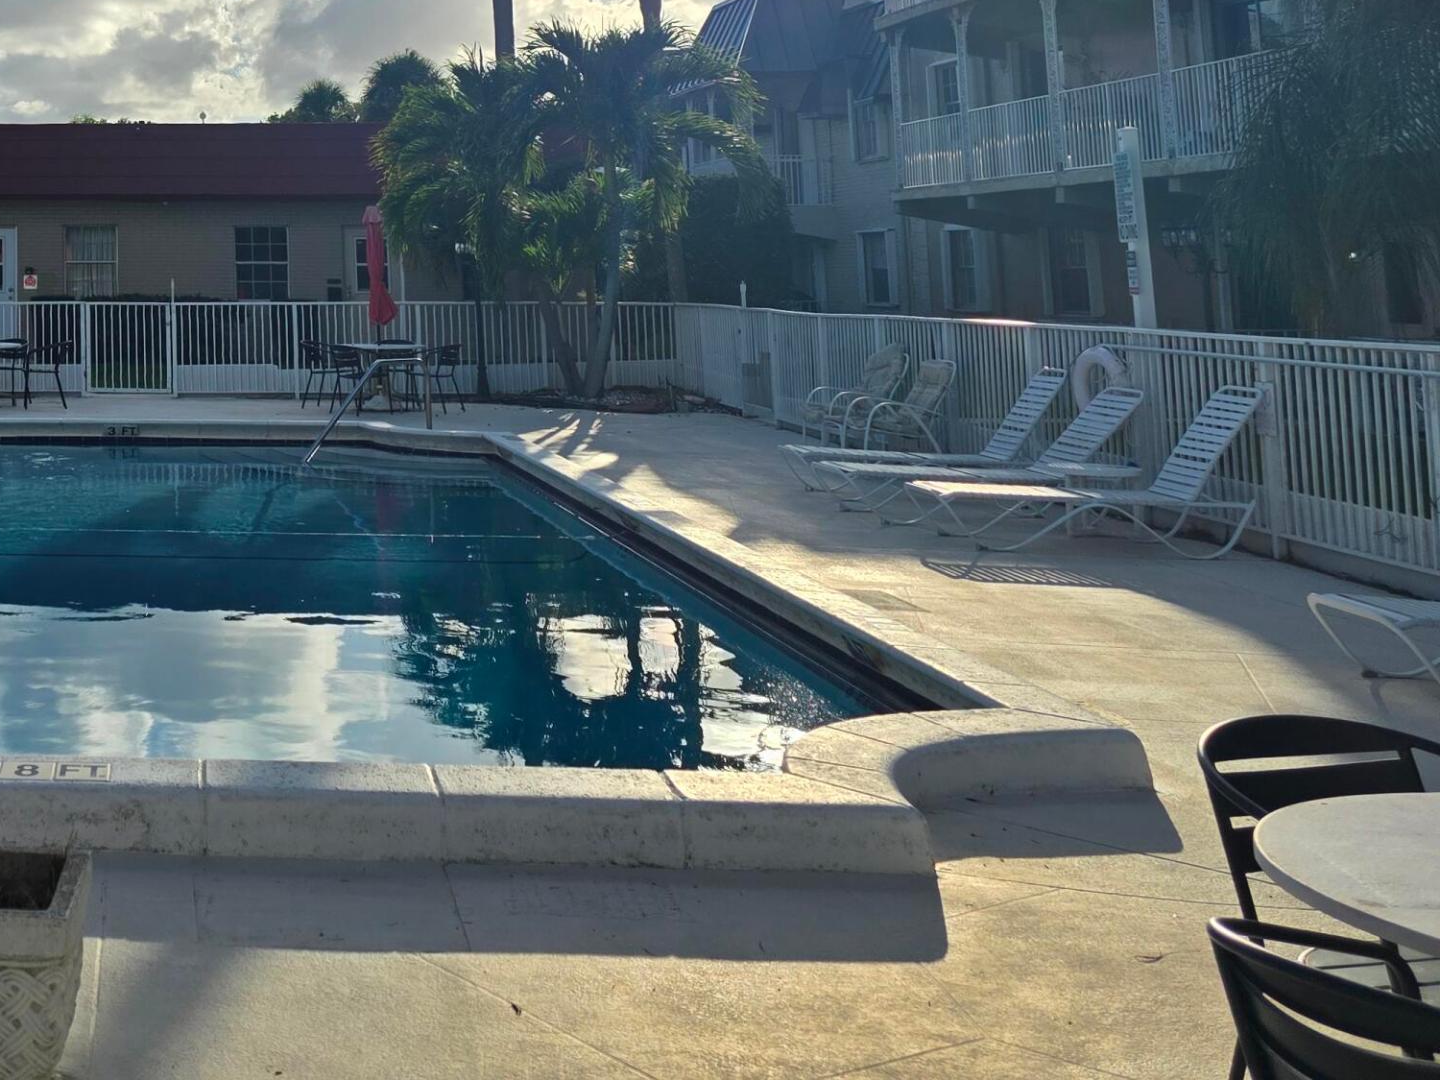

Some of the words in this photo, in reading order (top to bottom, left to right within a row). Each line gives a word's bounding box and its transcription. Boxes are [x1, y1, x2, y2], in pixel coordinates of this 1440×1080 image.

[107, 426, 116, 436] 3
[121, 426, 137, 436] FT
[14, 764, 39, 777] 8
